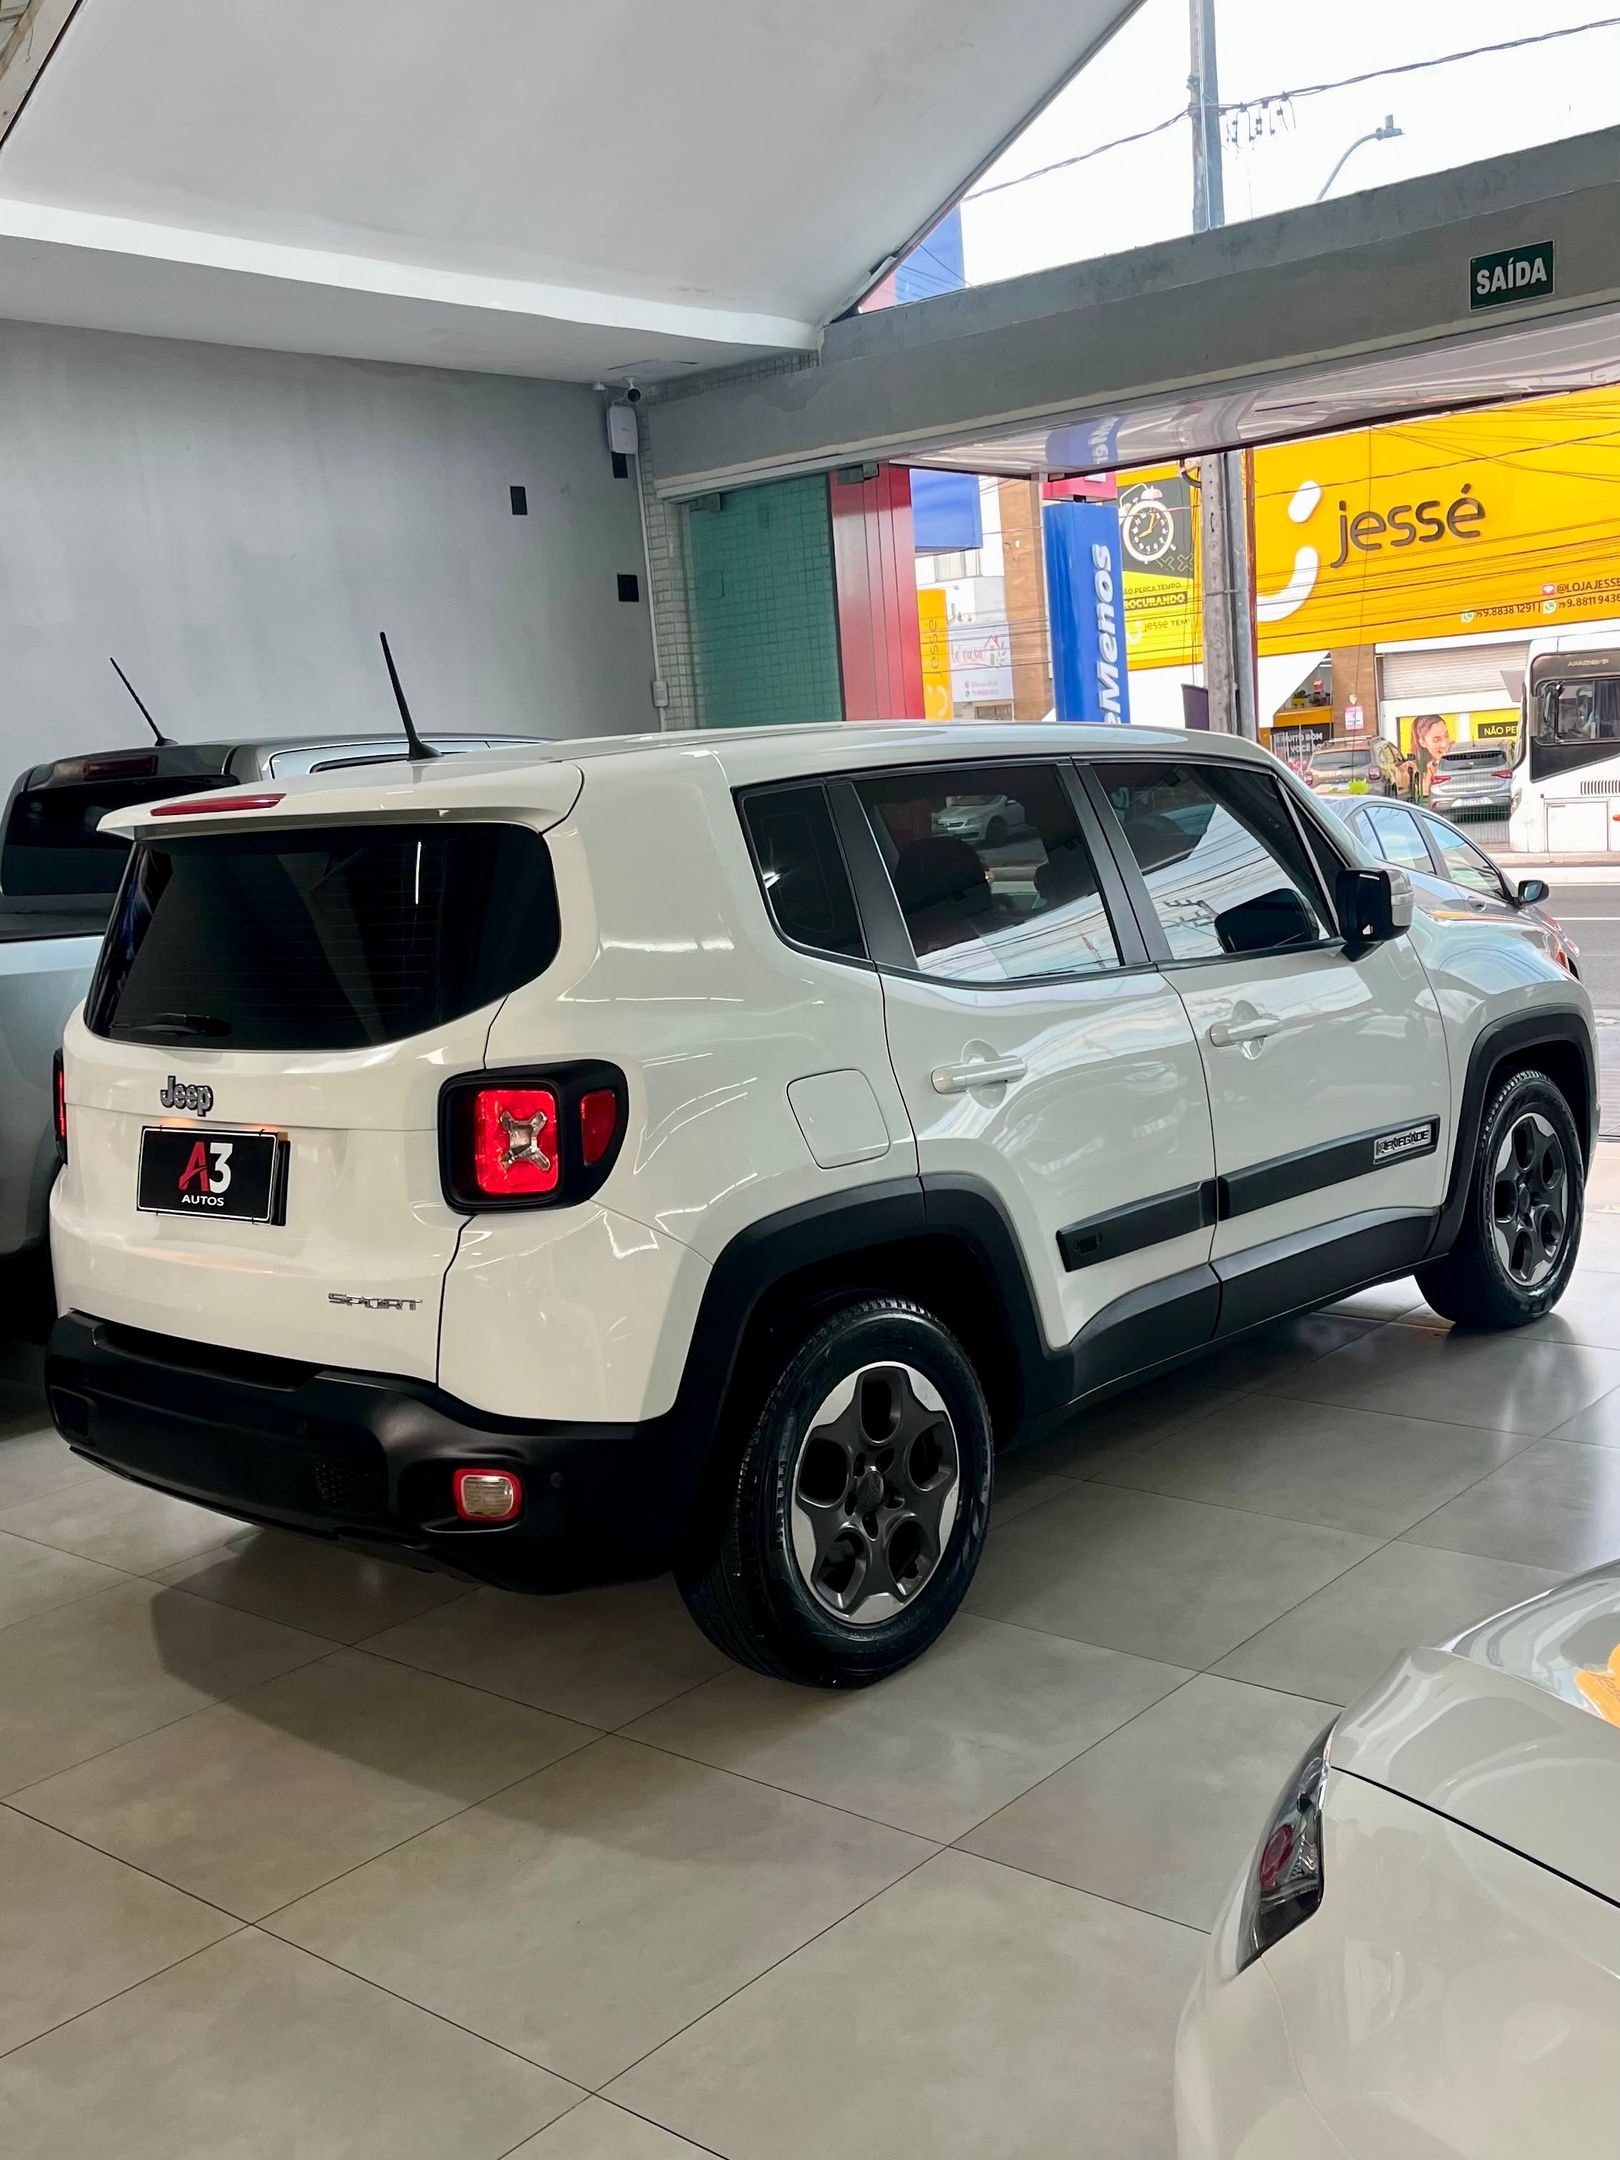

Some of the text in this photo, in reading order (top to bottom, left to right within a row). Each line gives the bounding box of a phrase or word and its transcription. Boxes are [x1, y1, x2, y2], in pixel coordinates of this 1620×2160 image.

[1476, 257, 1548, 295] SAÍDA
[1329, 483, 1486, 569] jessé
[1124, 593, 1185, 609] ROCURANDO
[1483, 725, 1504, 736] NÃO
[160, 1075, 214, 1117] Jeep
[178, 1141, 234, 1194] A3
[181, 1194, 225, 1206] AUTOS
